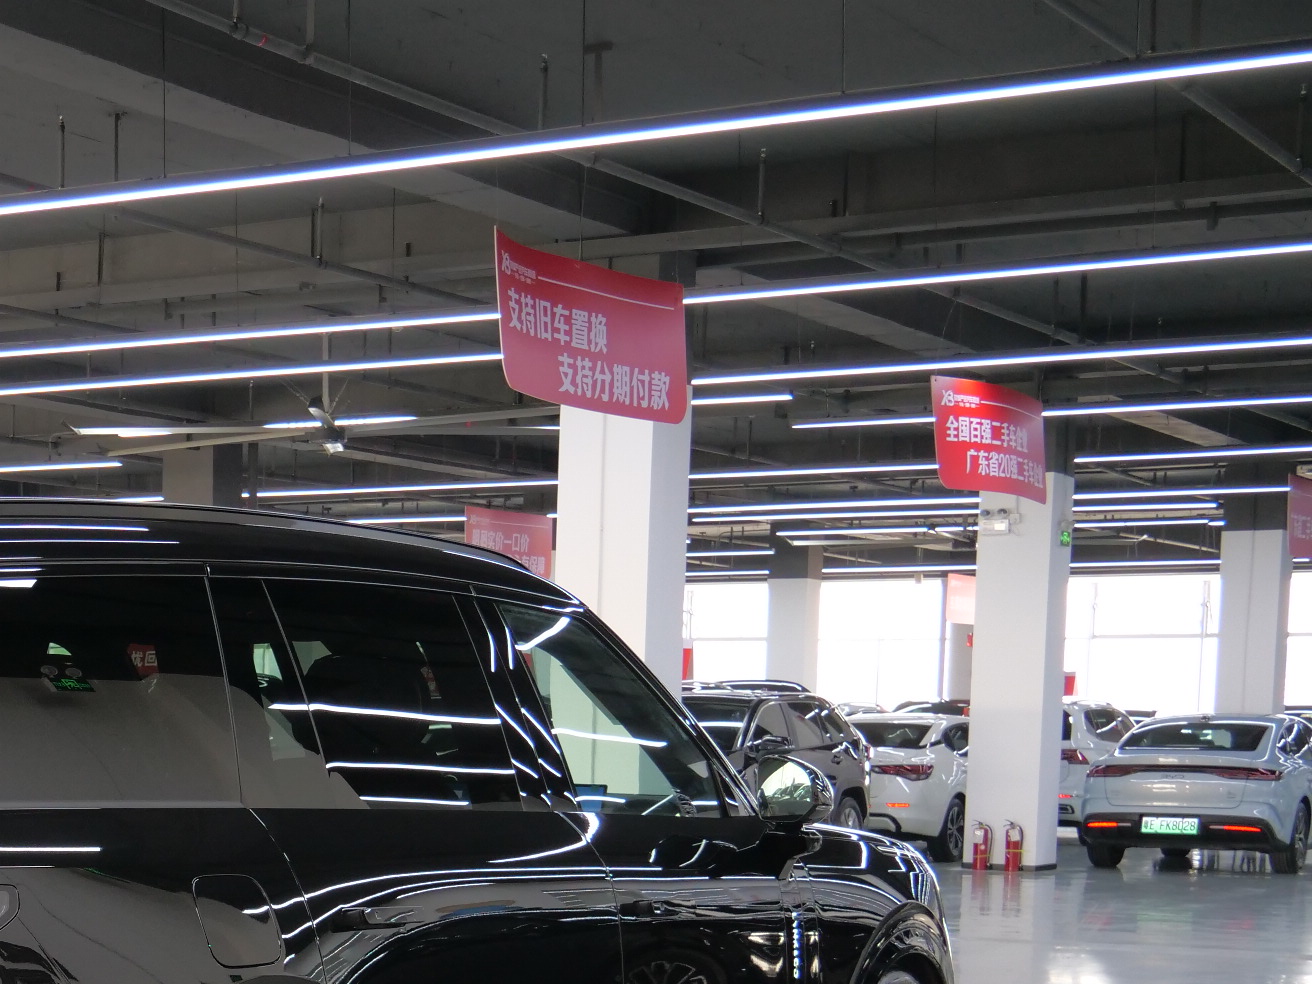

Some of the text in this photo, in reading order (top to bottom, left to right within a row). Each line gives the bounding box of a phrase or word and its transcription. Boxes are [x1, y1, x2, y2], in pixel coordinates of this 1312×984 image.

[507, 287, 608, 354] 支持旧车置换
[557, 352, 670, 411] 支持分期付款
[945, 415, 1028, 453] 全国百强二手车企业
[966, 449, 1044, 488] 广东省20强二手车企业
